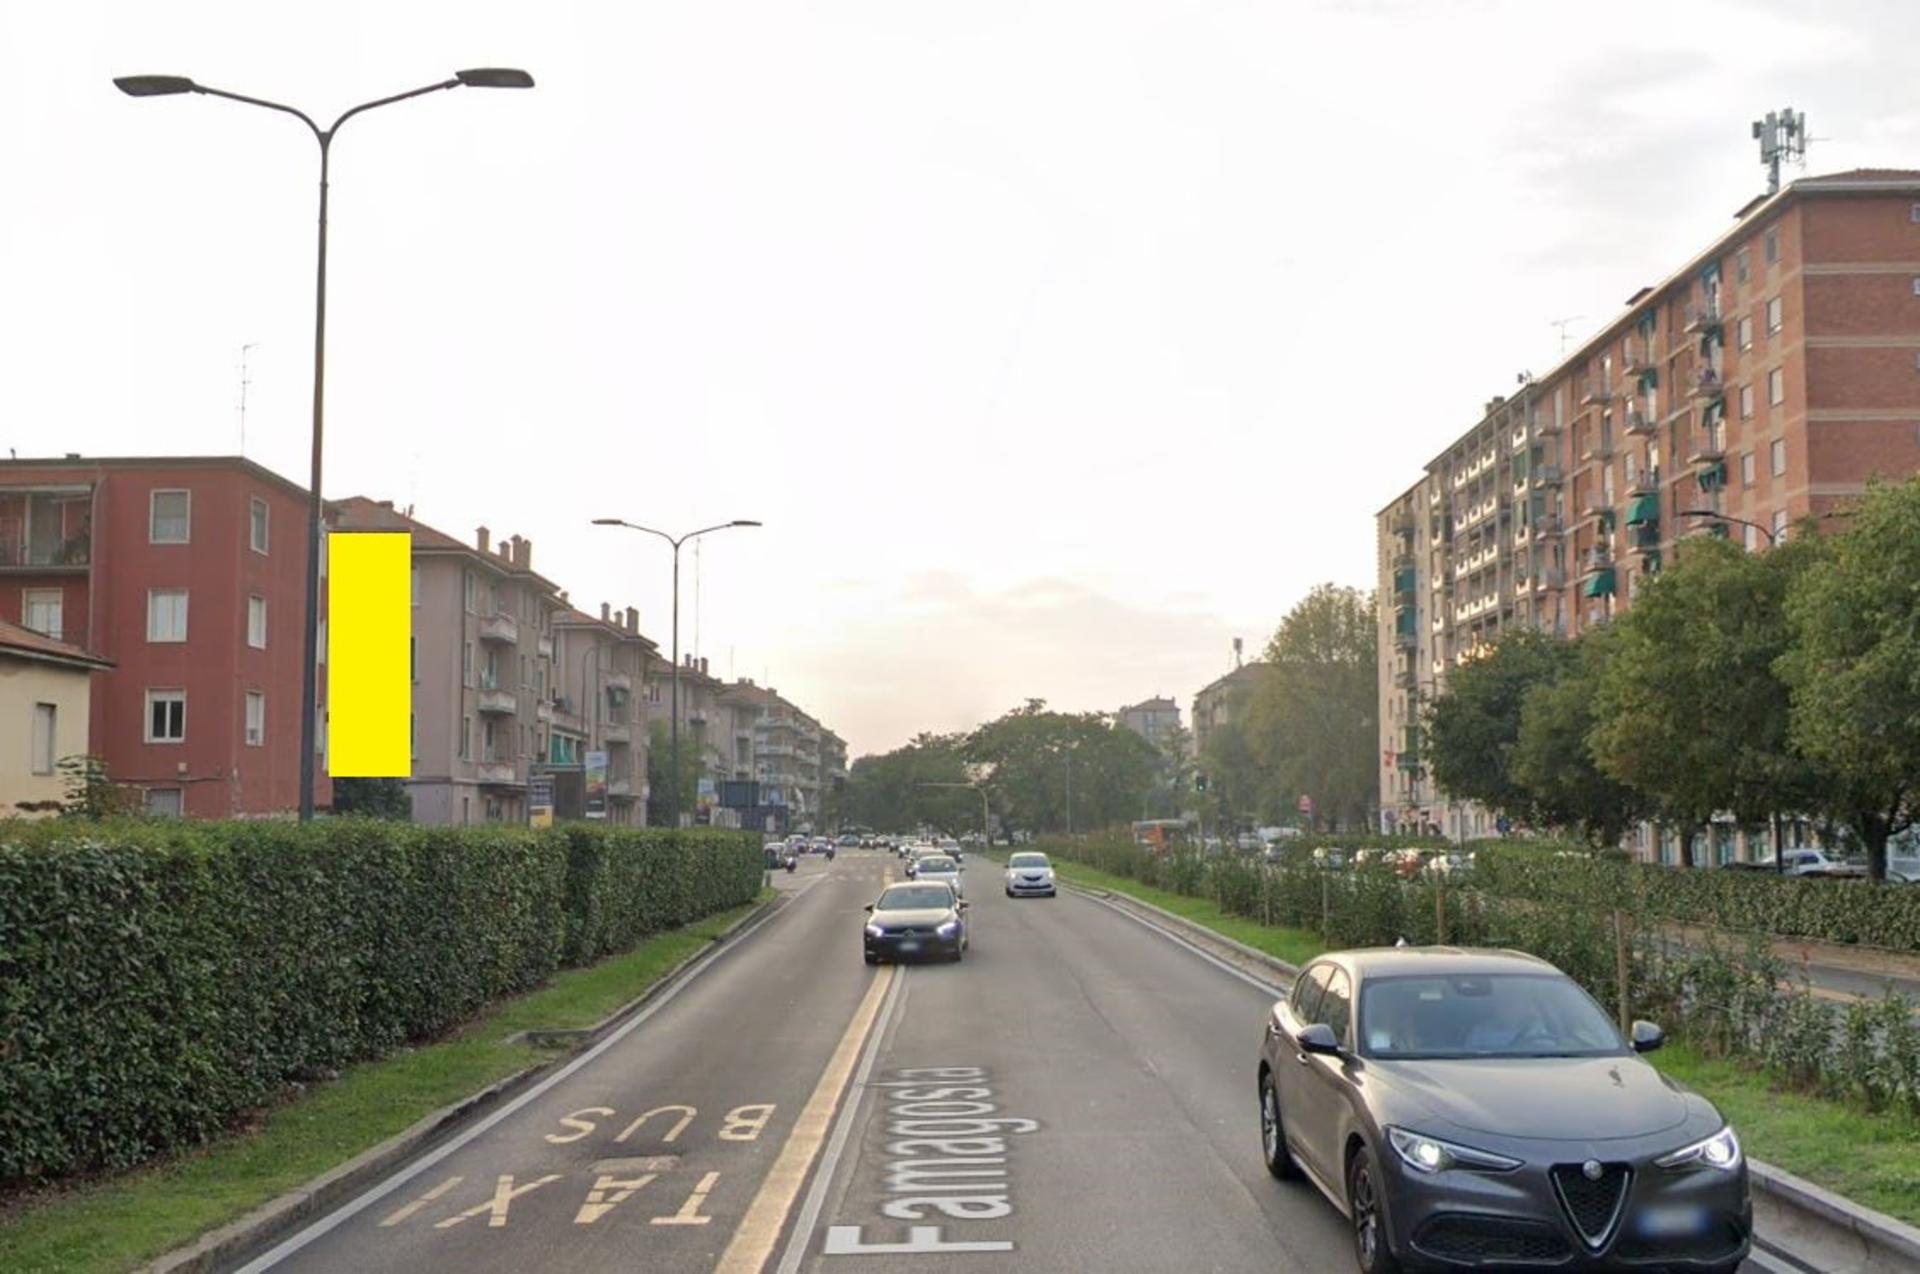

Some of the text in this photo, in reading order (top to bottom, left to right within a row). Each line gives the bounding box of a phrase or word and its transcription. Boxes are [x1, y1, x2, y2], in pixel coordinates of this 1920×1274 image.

[545, 1104, 777, 1143] BUS
[824, 1067, 1038, 1254] Famagosta
[377, 1171, 721, 1228] TAXI
